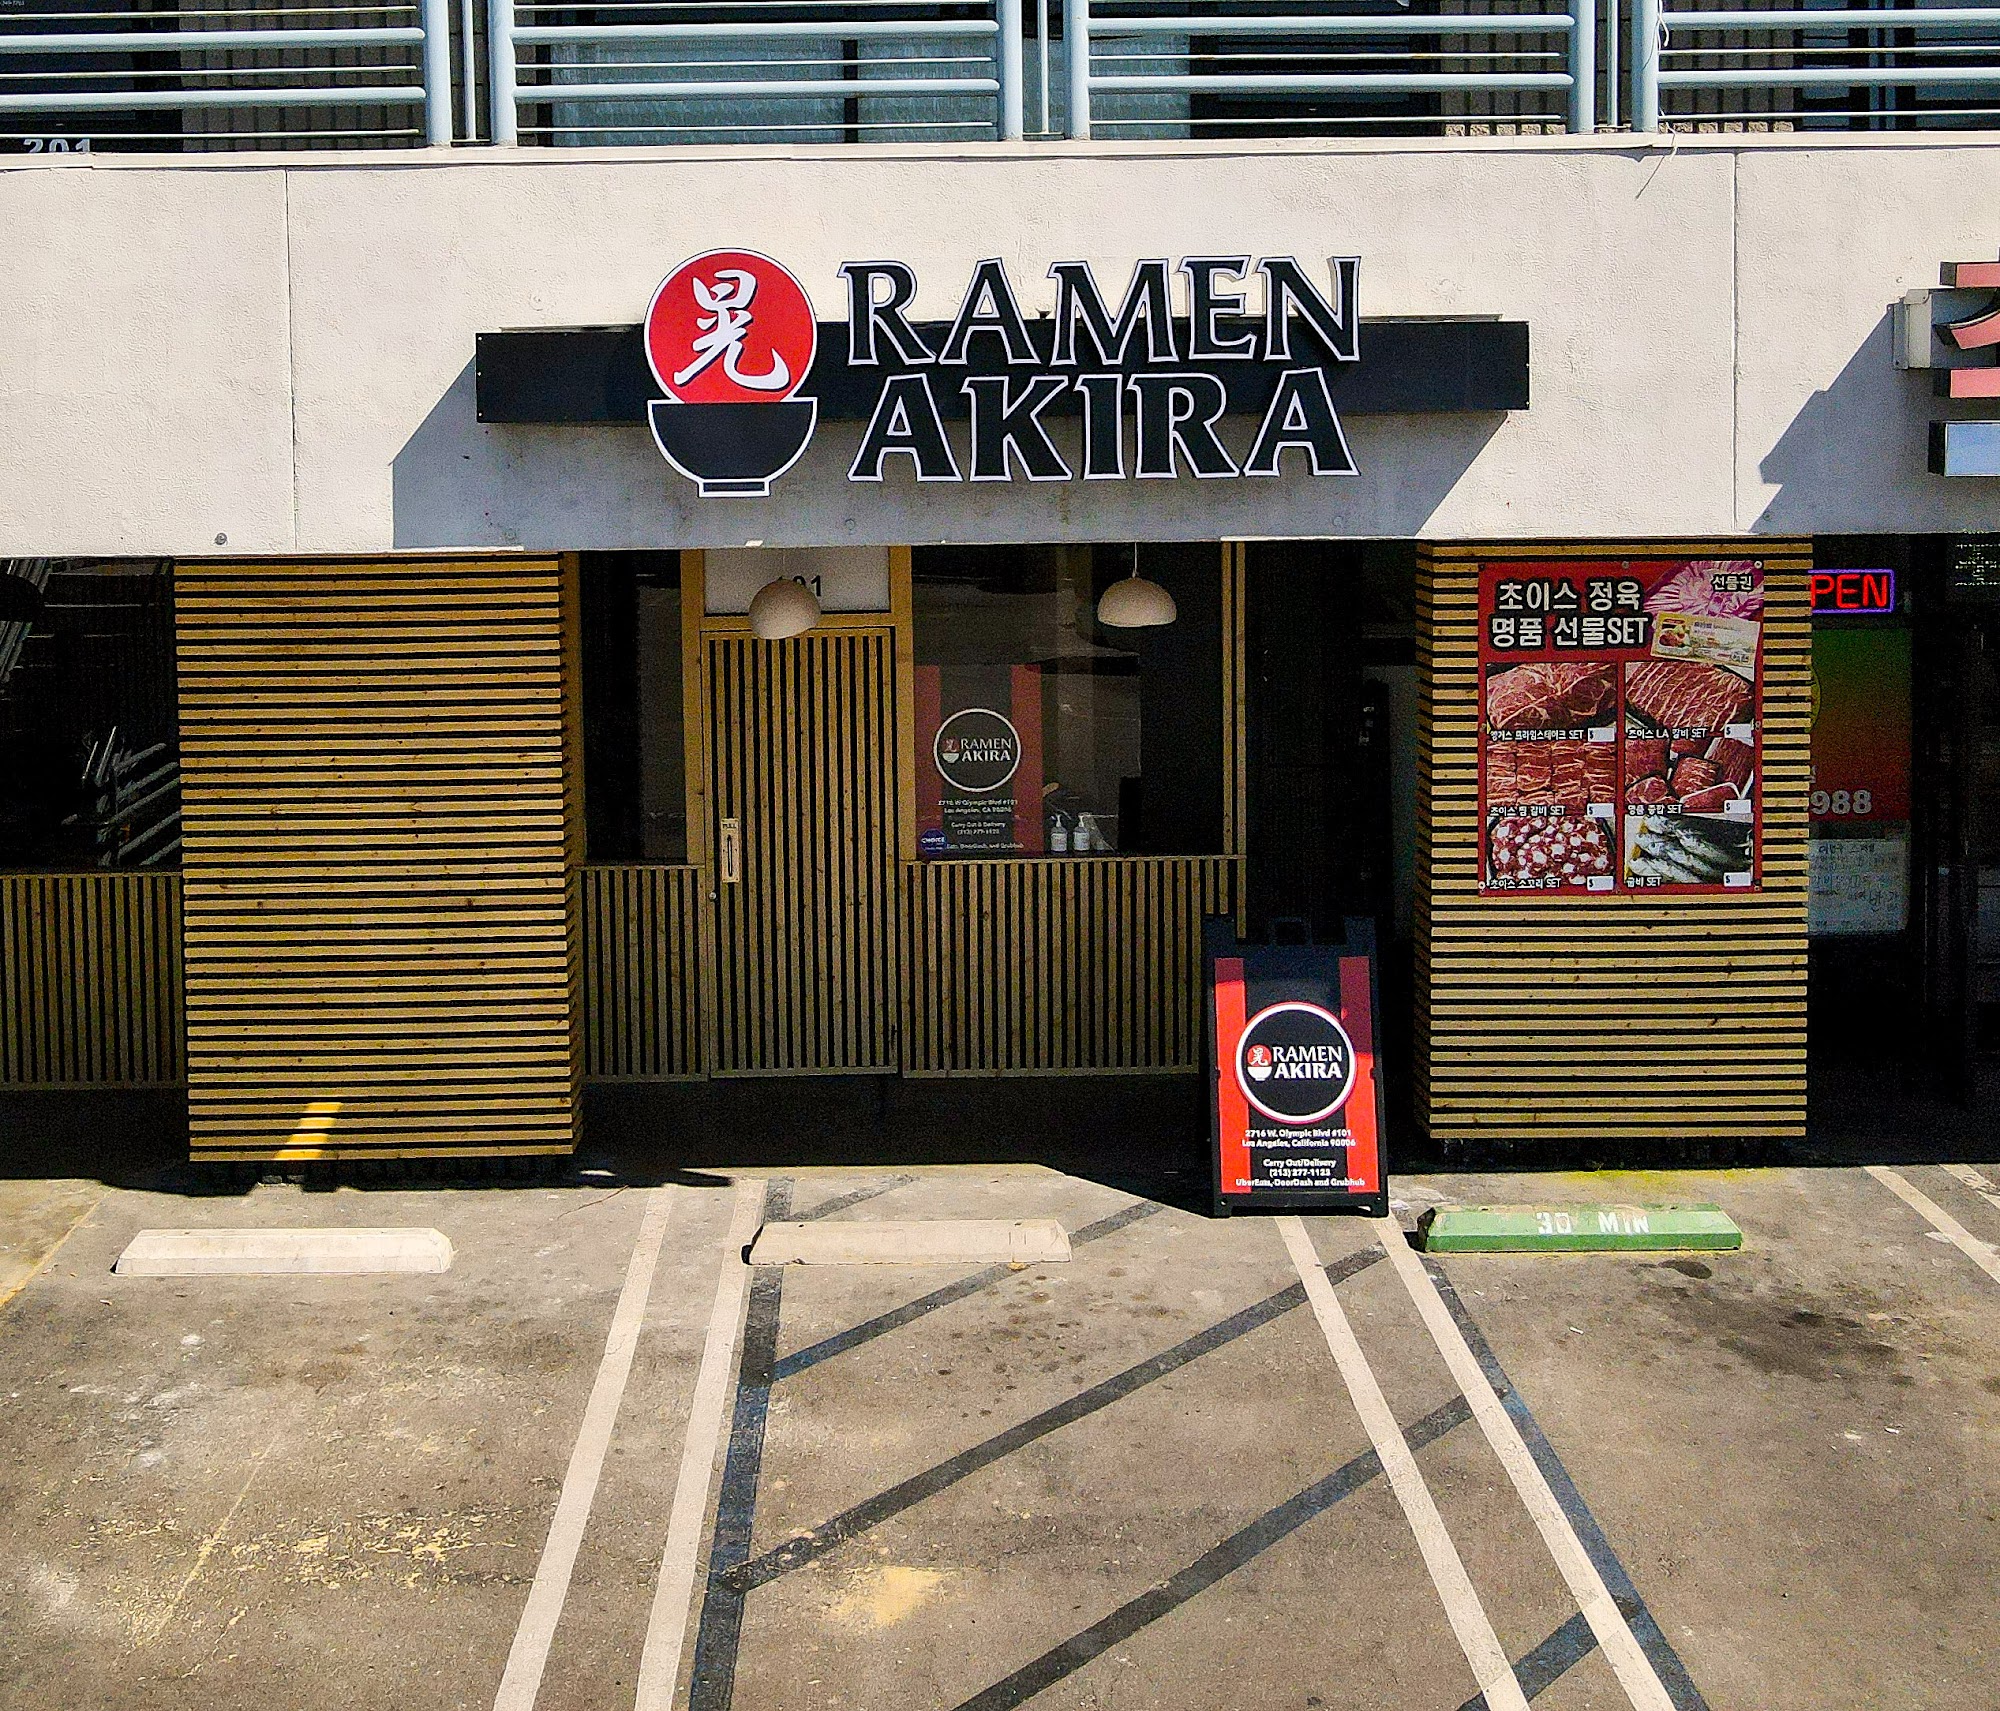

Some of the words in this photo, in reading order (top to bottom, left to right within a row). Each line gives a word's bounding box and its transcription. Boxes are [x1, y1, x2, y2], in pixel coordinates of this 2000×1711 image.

[838, 255, 1362, 367] RAMEN
[847, 367, 1360, 482] AKIRA
[1498, 582, 1577, 611] 초이스
[1589, 581, 1640, 611] 정육
[1810, 573, 1888, 609] PEN
[1492, 617, 1543, 648] 명품
[1554, 616, 1649, 646] 선물SET
[1568, 729, 1585, 740] SET
[1656, 728, 1670, 738] LA
[1691, 727, 1708, 738] SET
[960, 738, 1012, 750] RAMEN
[961, 750, 1011, 762] AKIRA
[1549, 805, 1566, 816] SET
[1667, 803, 1683, 814] SET
[1545, 878, 1562, 888] SET
[1645, 876, 1662, 887] SET
[1272, 1045, 1342, 1062] RAMEN
[1274, 1061, 1343, 1079] AKIRA
[1245, 1129, 1267, 1138] 2716
[1279, 1128, 1312, 1138] Olympic
[1312, 1128, 1331, 1137] Blvd
[1331, 1128, 1352, 1137] #101
[1242, 1138, 1256, 1147] Los
[1256, 1138, 1291, 1149] Angeles,
[1291, 1138, 1329, 1147] California
[1330, 1138, 1356, 1147] 90006
[1262, 1158, 1285, 1169] Carry
[1269, 1168, 1291, 1178] (213)
[1314, 1177, 1330, 1187] and
[1330, 1176, 1365, 1187] Grubhub
[1537, 1212, 1572, 1234] 30
[1598, 1212, 1650, 1234] MIN
